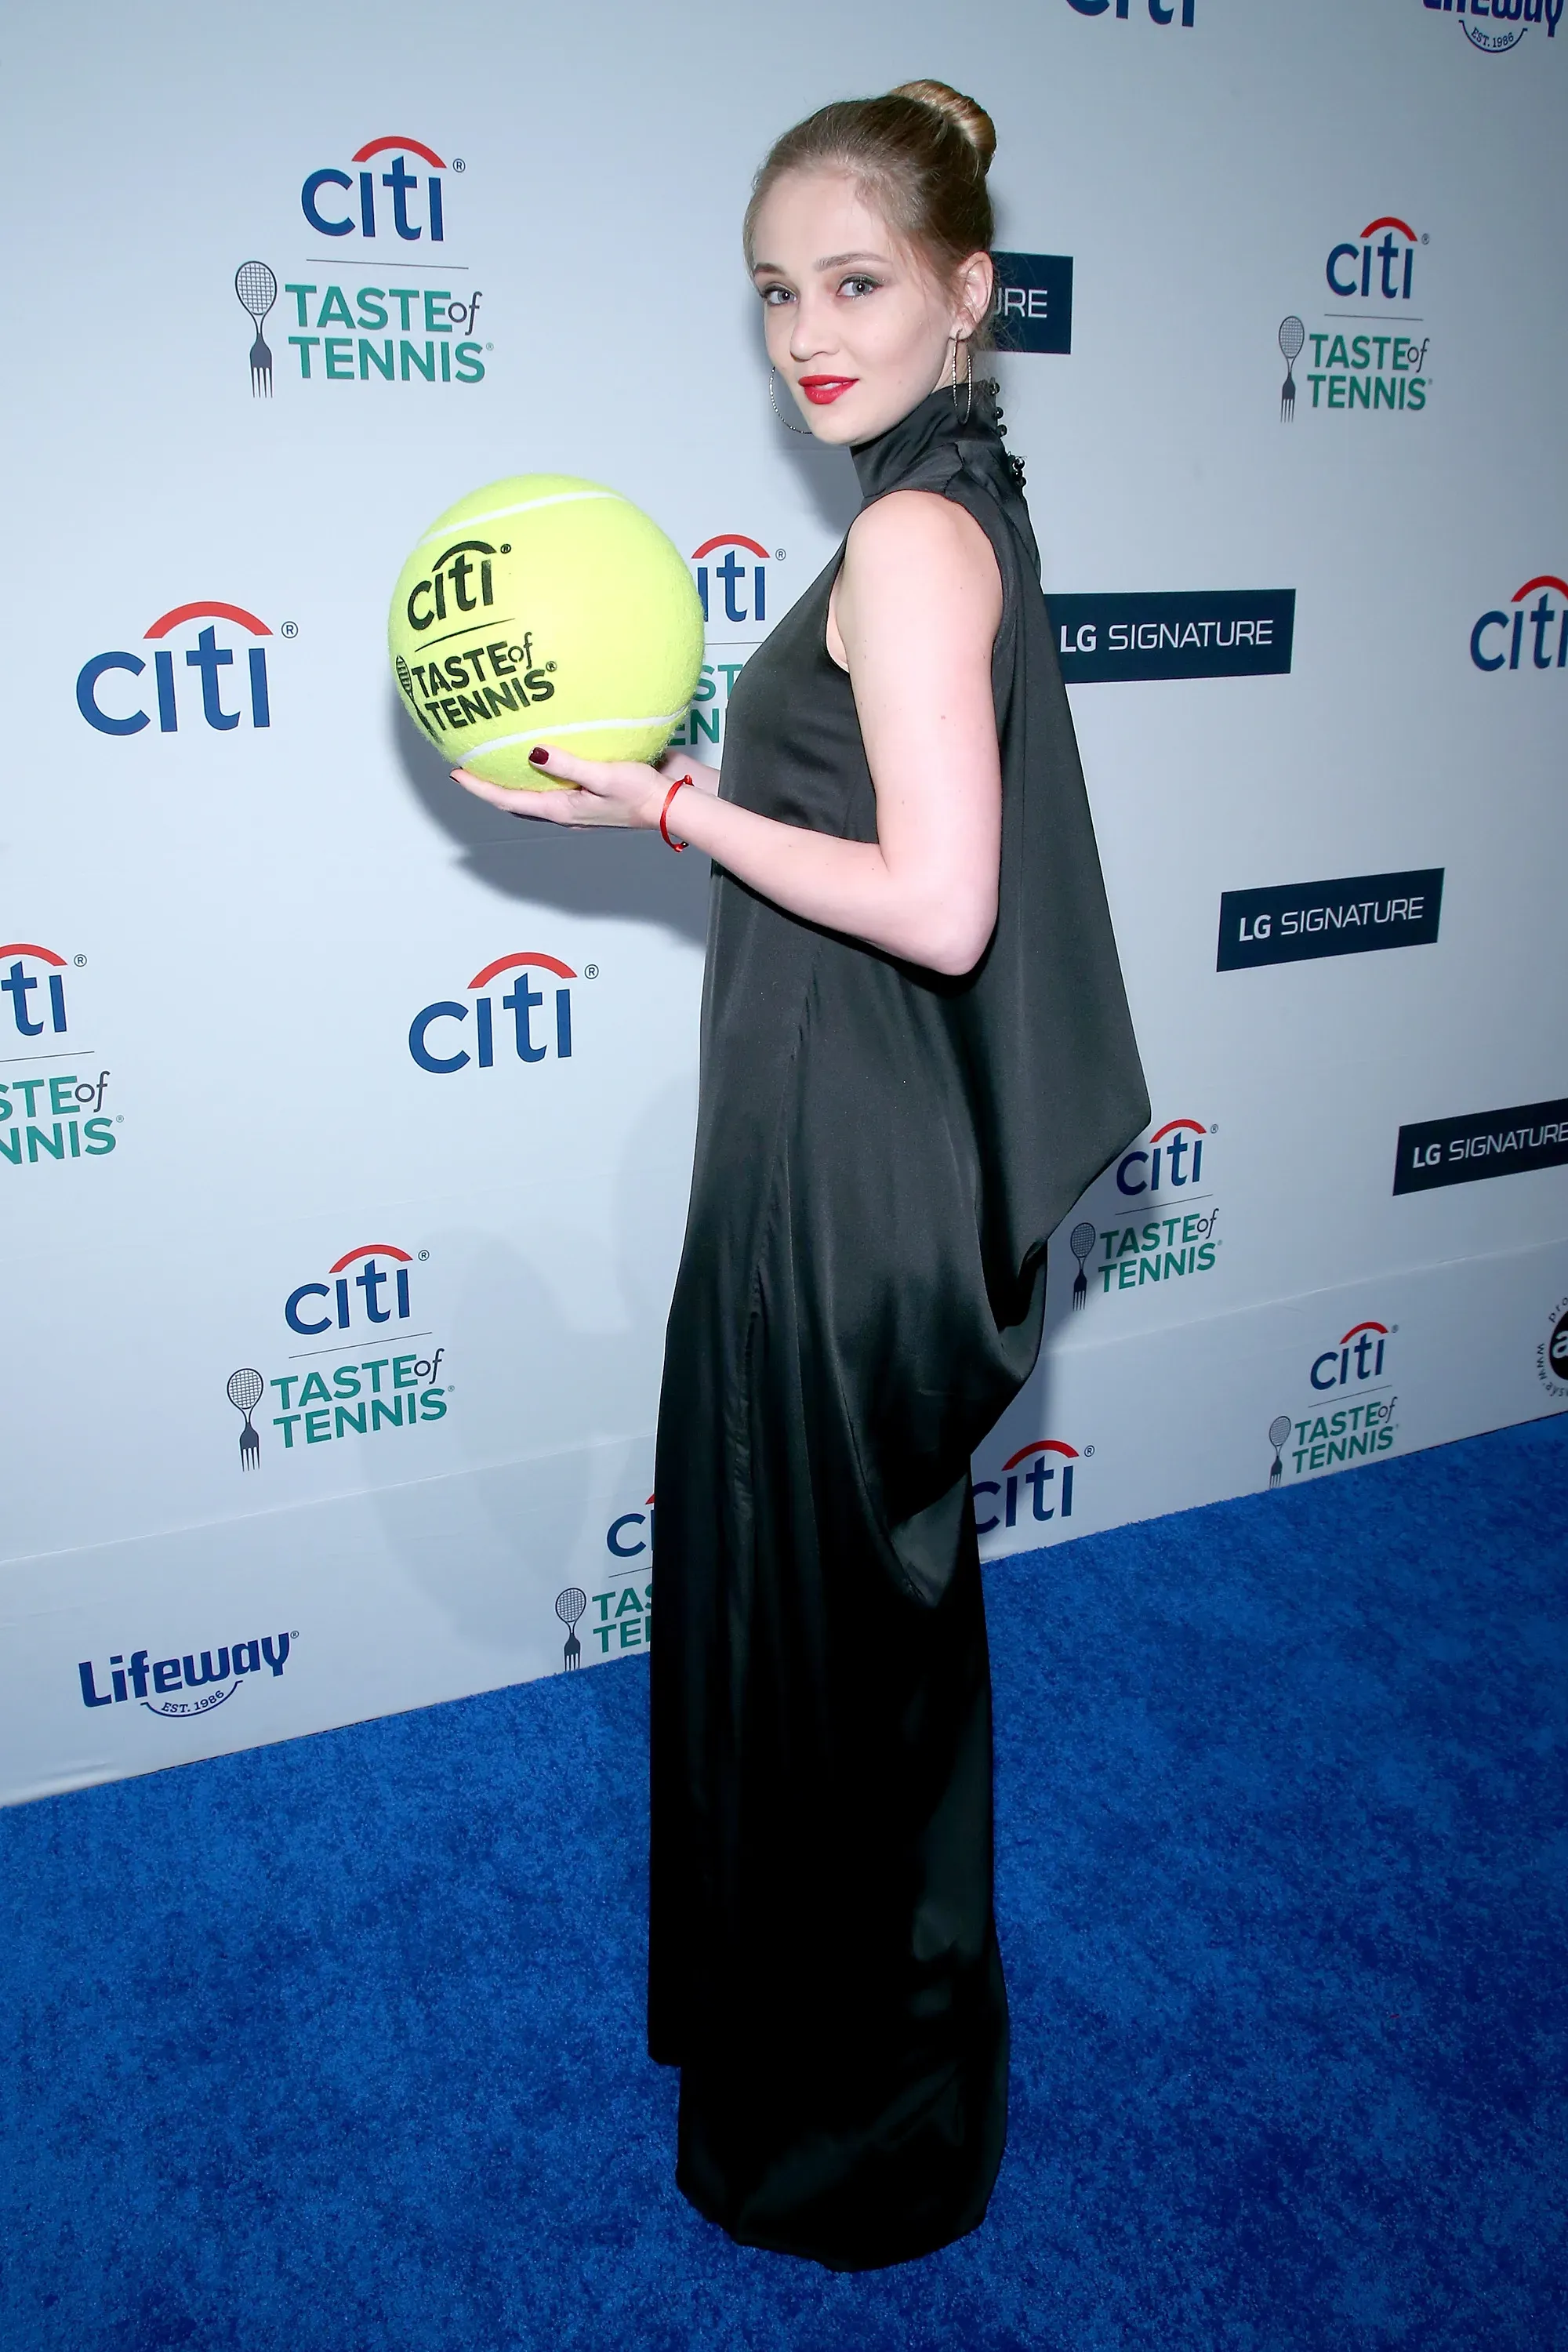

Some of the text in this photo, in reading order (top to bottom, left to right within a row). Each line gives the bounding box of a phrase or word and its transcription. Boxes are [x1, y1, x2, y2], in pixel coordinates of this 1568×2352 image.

[1471, 27, 1515, 48] EST. 1986
[301, 155, 444, 241] citi
[1326, 232, 1414, 299] citi
[285, 284, 483, 336] TASTE of
[288, 336, 485, 383] TENNIS
[1309, 334, 1430, 372] TASTE of
[1307, 375, 1426, 411] TENNIS
[407, 554, 494, 631] citi
[697, 550, 766, 622] iti
[1060, 619, 1274, 652] LG SIGNATURE
[76, 625, 271, 736] citi
[411, 632, 533, 698] TASTE of
[424, 669, 555, 731] TENNIS
[1239, 897, 1425, 942] LG SIGNATURE
[408, 973, 573, 1074] citi
[74, 1071, 111, 1112] of
[0, 1117, 117, 1165] NNIS
[1116, 1132, 1203, 1196] citi
[1413, 1122, 1568, 1168] LG SIGNATURE
[1100, 1208, 1219, 1260] TASTE of
[1098, 1243, 1216, 1293] TENNIS
[285, 1259, 410, 1335] citi
[270, 1348, 445, 1410] TASTE of
[1310, 1333, 1385, 1390] citi
[273, 1388, 448, 1448] TENNIS
[1294, 1396, 1398, 1446] TASTE of
[1292, 1426, 1394, 1474] TENNIS
[78, 1632, 289, 1708] Lifeway
[161, 1690, 224, 1713] EST. 1986
